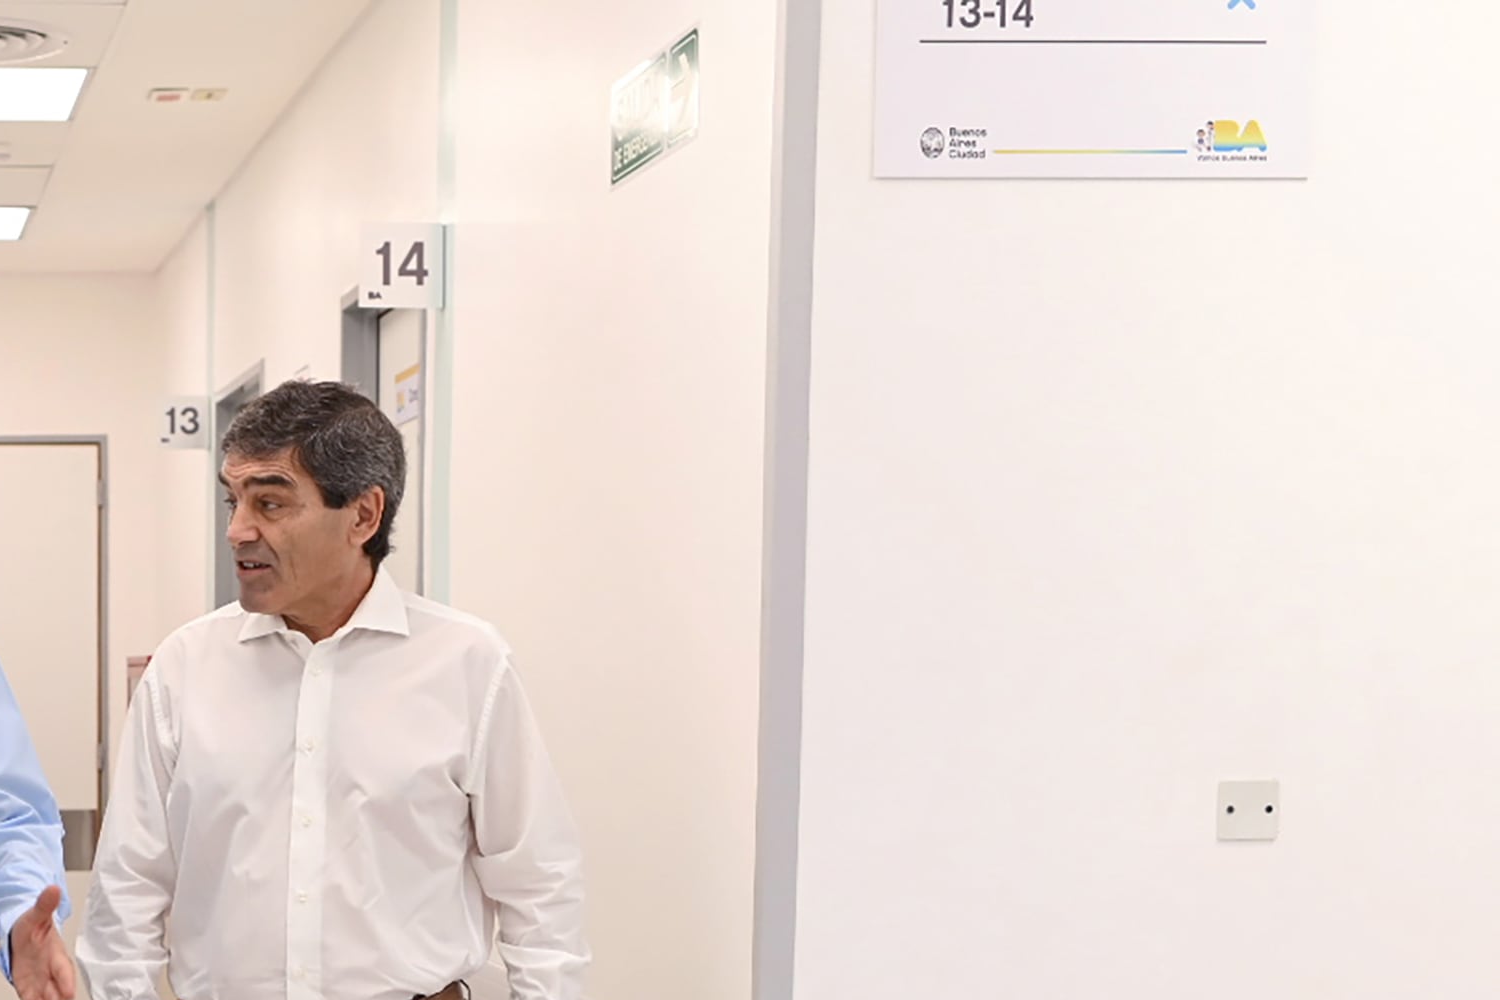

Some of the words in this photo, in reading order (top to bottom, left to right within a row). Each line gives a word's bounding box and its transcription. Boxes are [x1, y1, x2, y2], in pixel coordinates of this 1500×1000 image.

[943, 0, 1034, 28] 13-14
[948, 127, 987, 137] Buenos
[948, 138, 977, 147] Aires
[1213, 119, 1267, 152] BA
[948, 148, 986, 159] Ciudad
[375, 241, 429, 286] 14
[165, 407, 200, 434] 13
